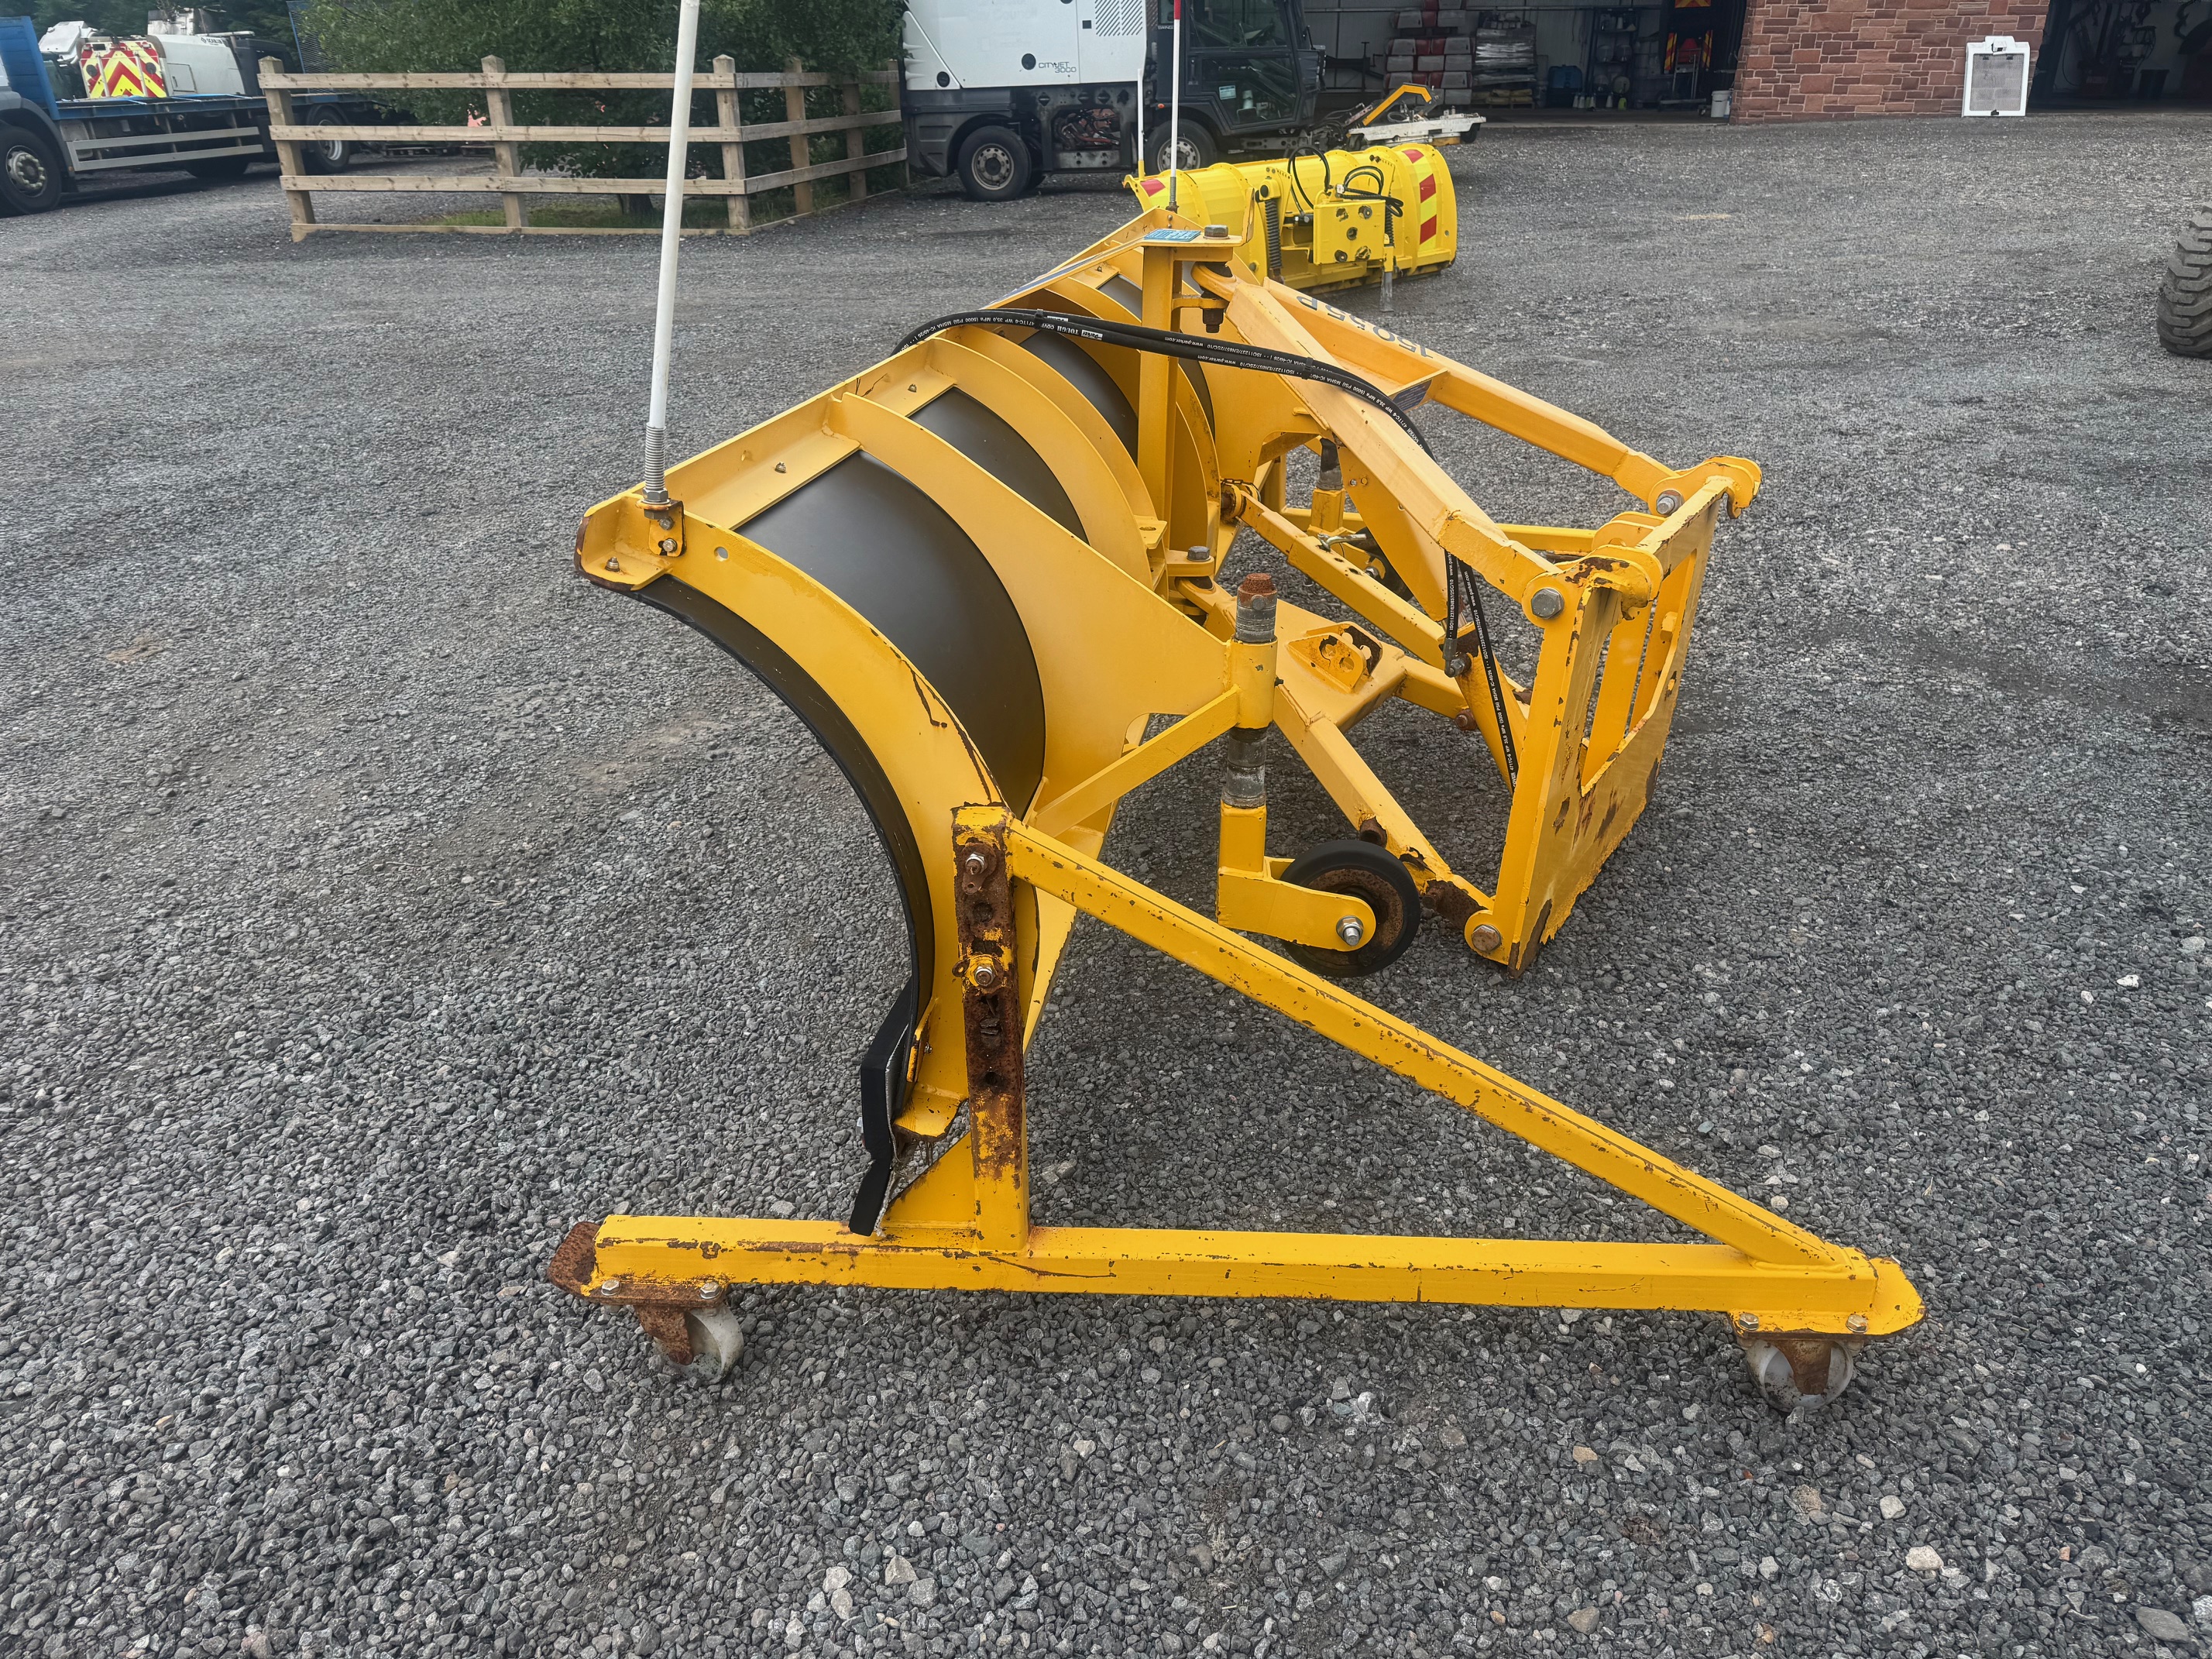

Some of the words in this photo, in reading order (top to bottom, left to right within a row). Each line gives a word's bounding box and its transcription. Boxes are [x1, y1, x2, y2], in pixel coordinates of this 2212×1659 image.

[936, 320, 952, 329] MSHA
[1057, 325, 1079, 335] TOUGH
[1164, 336, 1204, 347] www.parker.com
[1197, 355, 1236, 365] www.parker.com
[1327, 377, 1341, 386] MSHA
[1366, 393, 1376, 401] MPa
